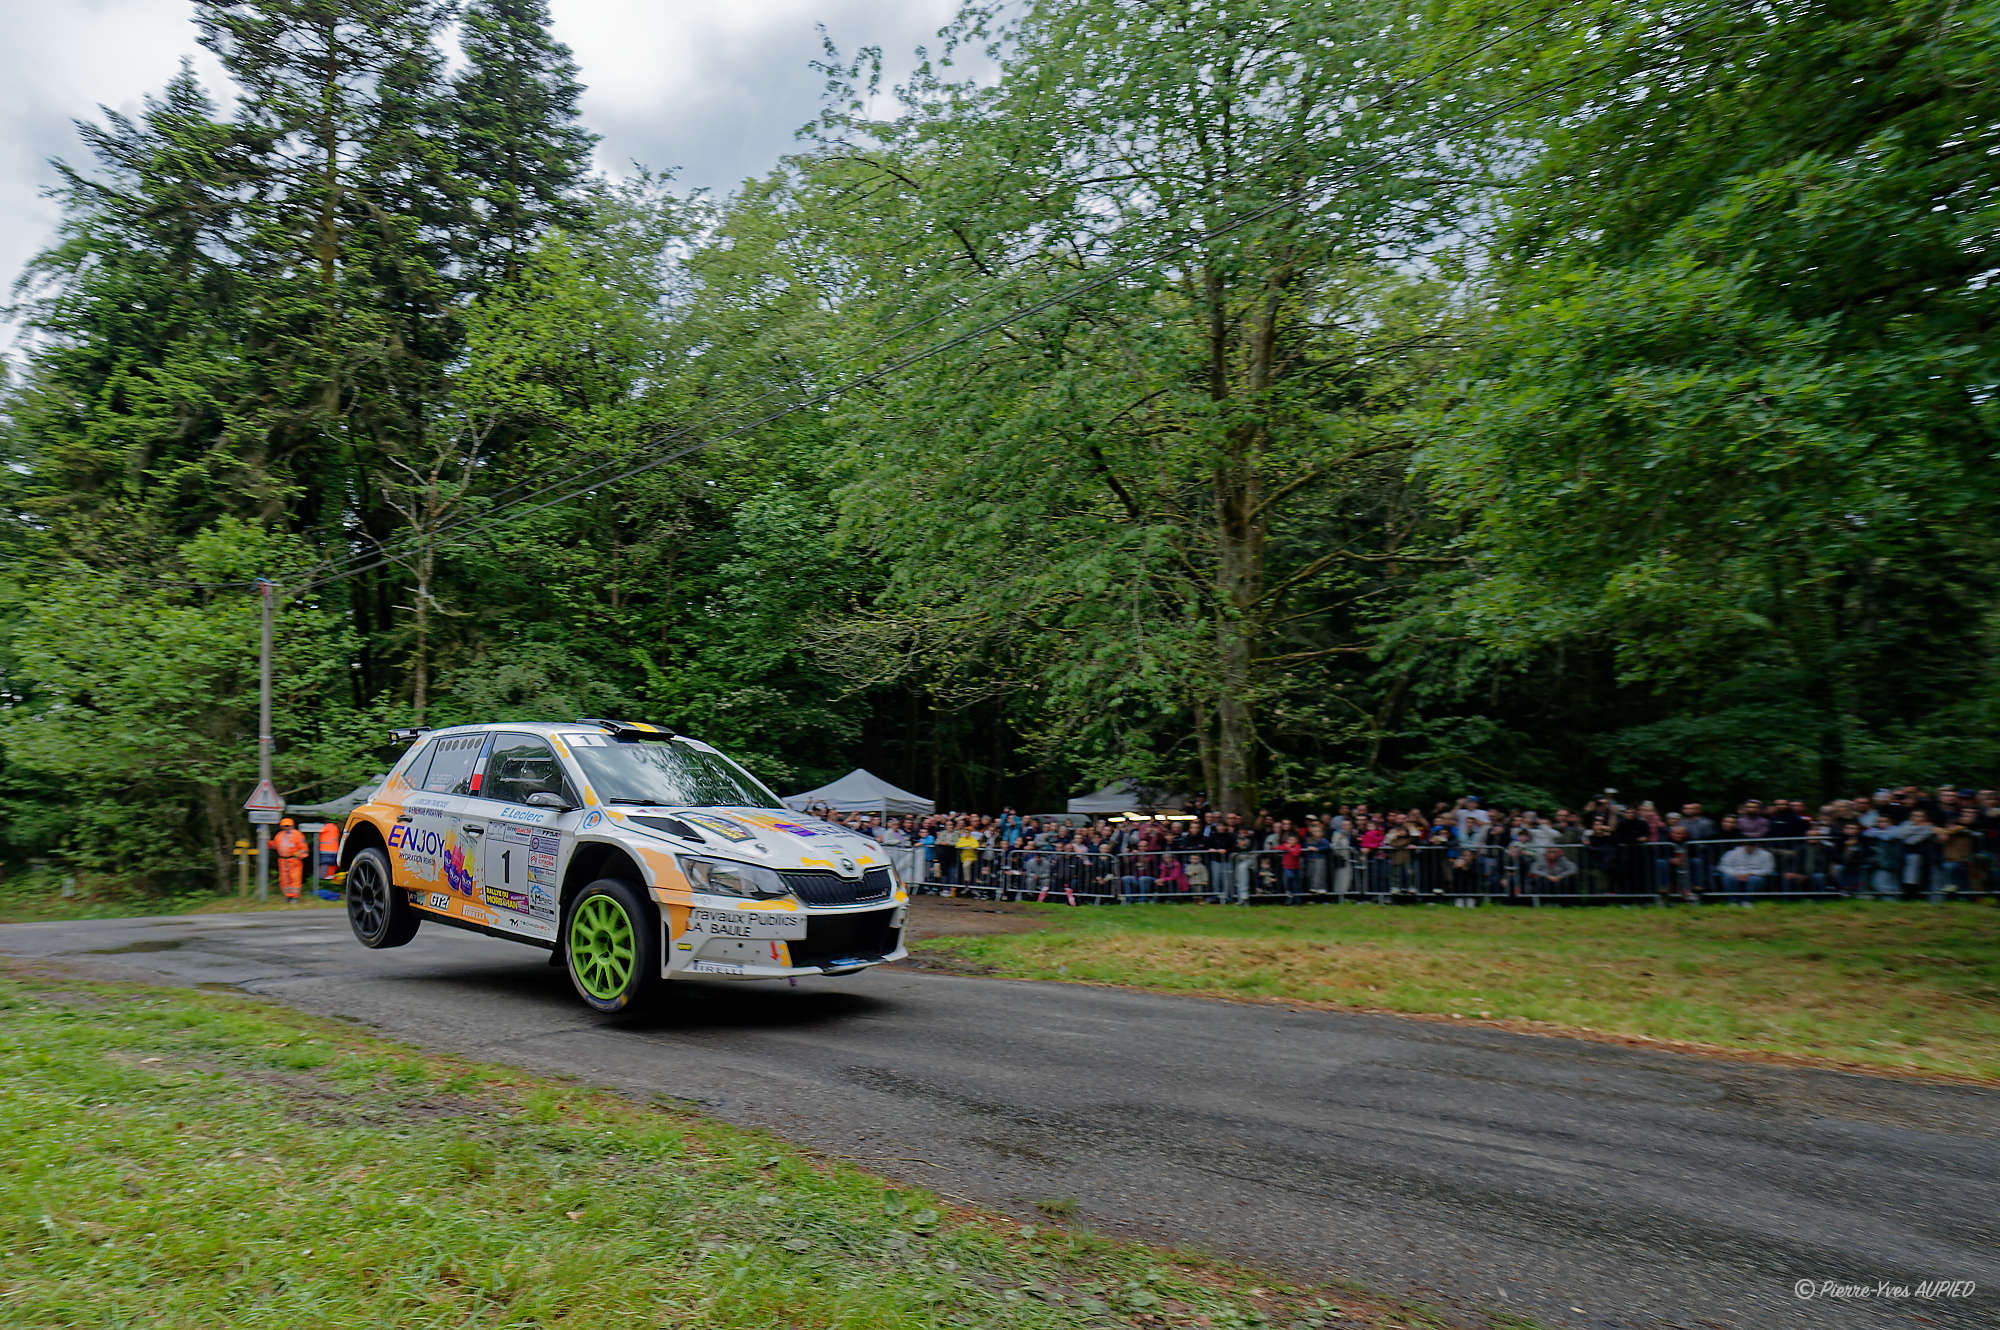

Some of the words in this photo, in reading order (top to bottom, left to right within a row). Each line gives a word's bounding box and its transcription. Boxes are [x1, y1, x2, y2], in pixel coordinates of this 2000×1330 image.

[579, 735, 592, 746] 1
[388, 824, 446, 858] ENJOY
[501, 850, 511, 884] 1
[486, 887, 502, 896] RALLYE
[501, 891, 509, 899] DU
[749, 912, 798, 927] Publics
[711, 923, 752, 938] BAULE
[693, 960, 744, 976] PIRELLI
